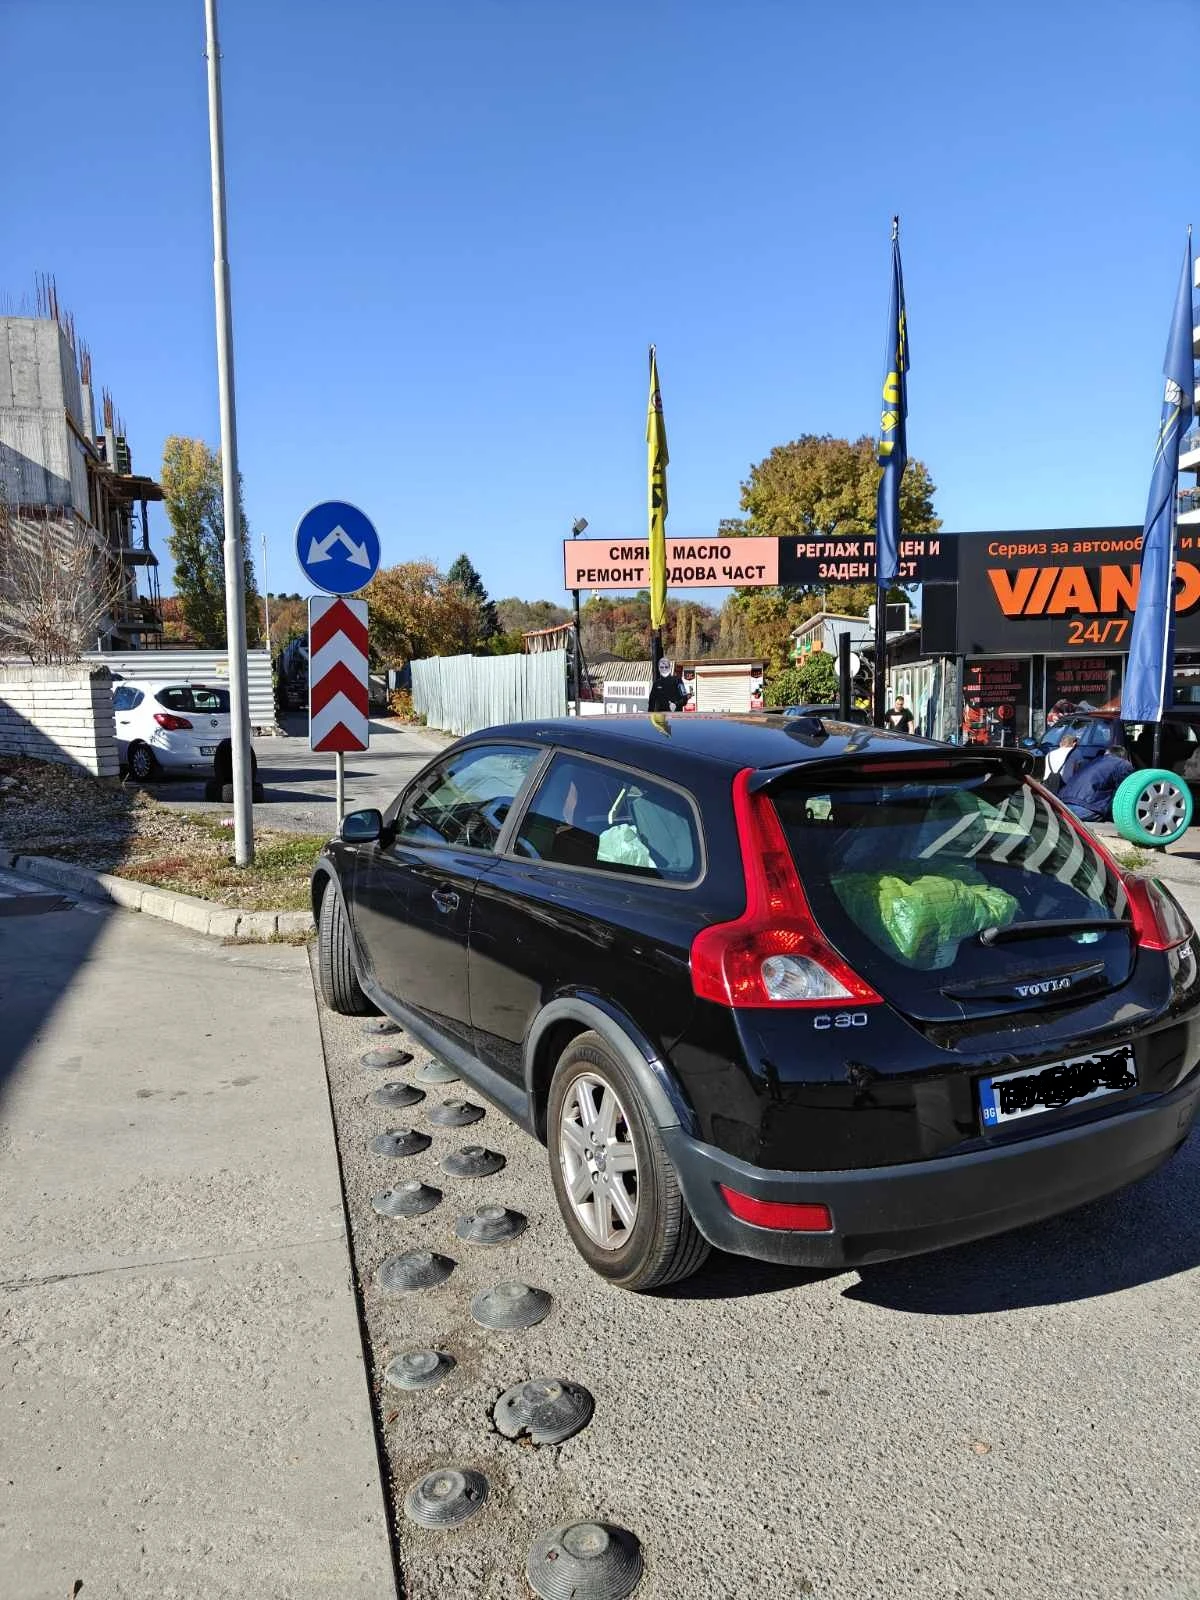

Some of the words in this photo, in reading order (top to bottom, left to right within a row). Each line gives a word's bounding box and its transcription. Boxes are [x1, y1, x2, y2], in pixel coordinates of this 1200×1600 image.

[672, 545, 731, 560] МАСЛО
[796, 541, 859, 557] РЕГЛАЖ
[930, 540, 940, 555] И
[988, 541, 1047, 559] Сервиз
[1051, 541, 1069, 554] за
[1181, 537, 1193, 550] и
[576, 567, 644, 583] РЕМОНТ
[722, 565, 766, 580] ЧАСТ
[818, 562, 869, 580] ЗАДЕН
[1068, 619, 1128, 644] 24/7
[813, 1012, 868, 1030] C30
[984, 1107, 996, 1119] BG
